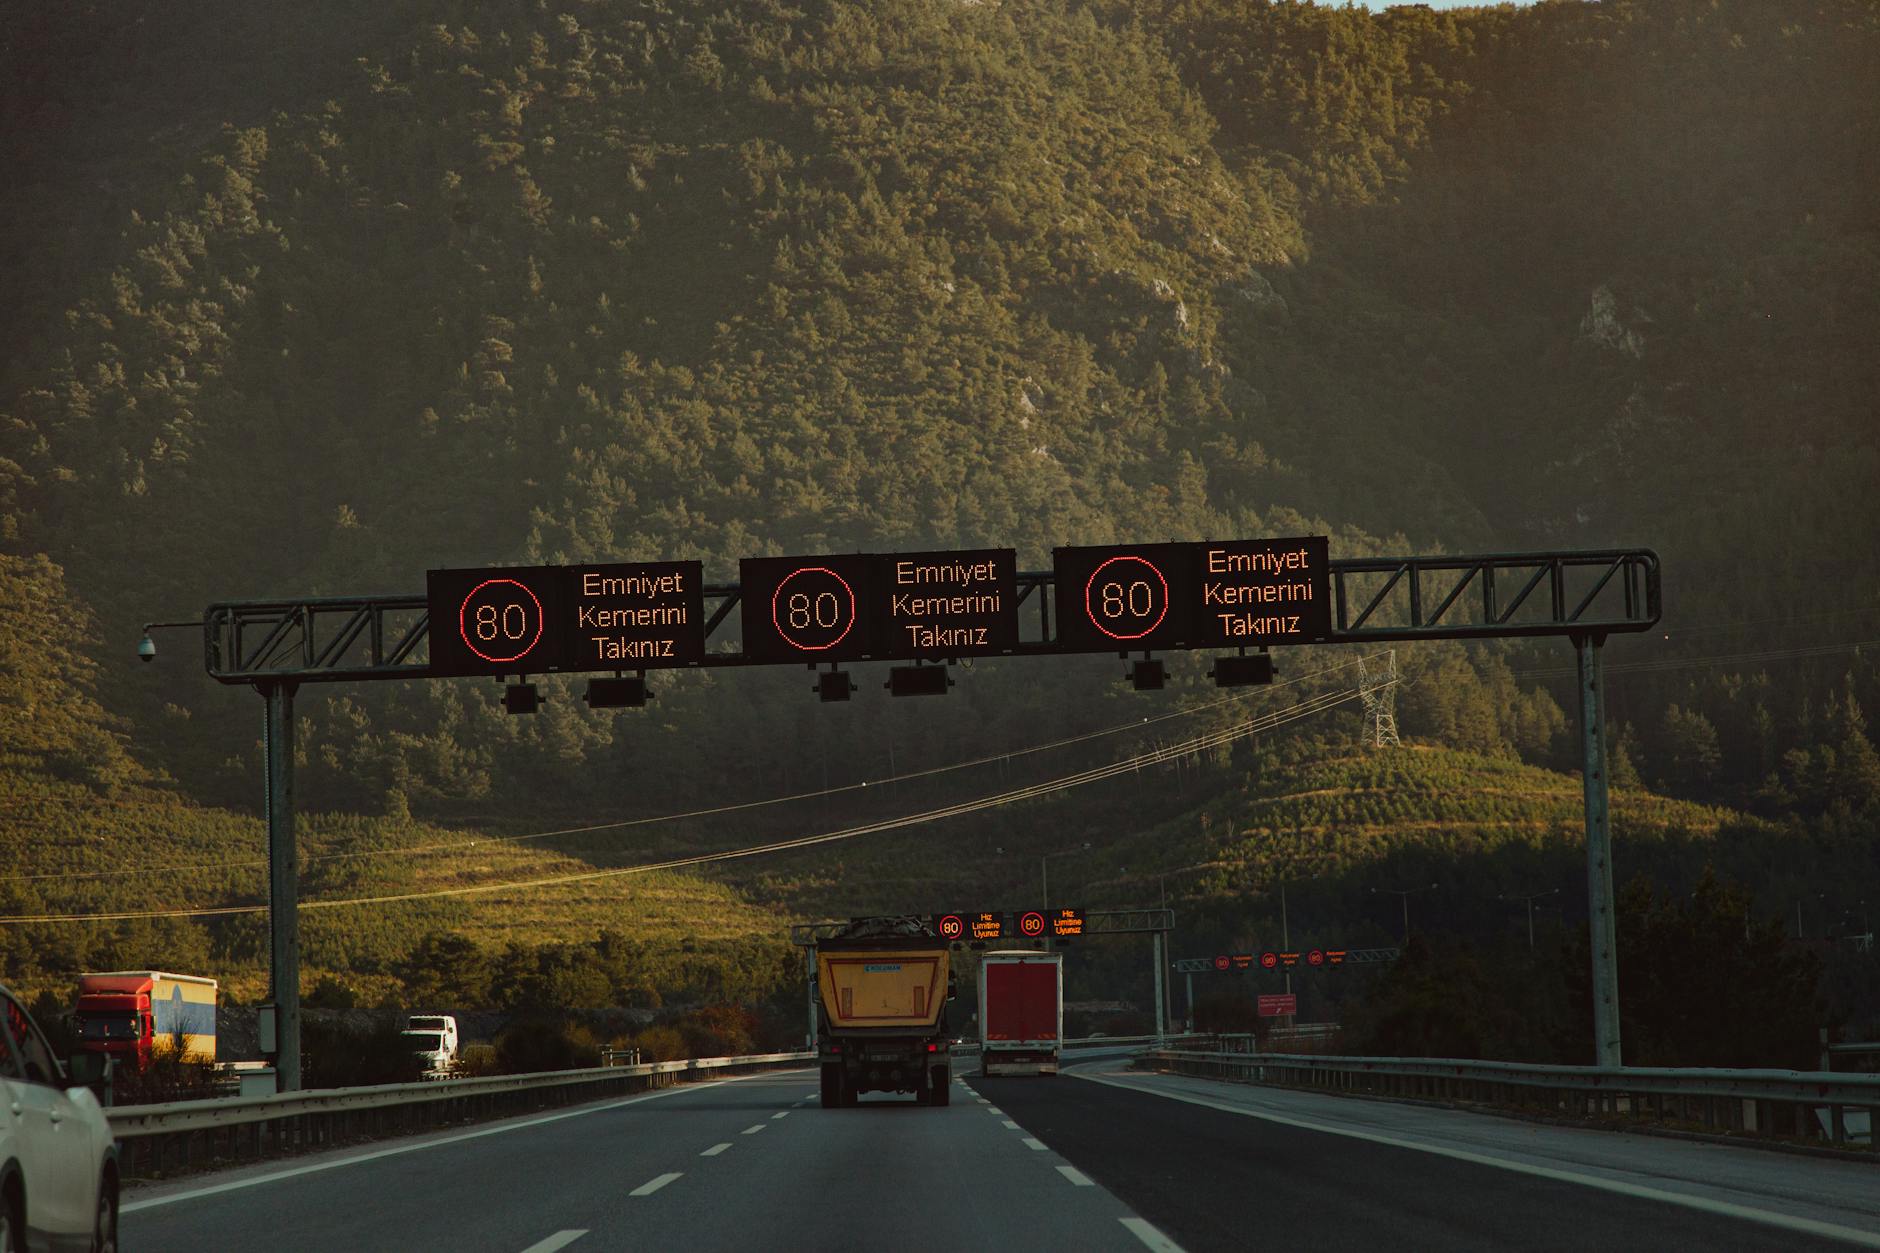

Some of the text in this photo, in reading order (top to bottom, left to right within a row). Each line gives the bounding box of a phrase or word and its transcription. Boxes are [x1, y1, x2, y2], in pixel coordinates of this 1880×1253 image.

[898, 560, 996, 587] Emniyet
[1209, 548, 1308, 575] Emniyet
[584, 572, 683, 598] Emniyet
[1205, 578, 1312, 604] Kemerini
[790, 593, 838, 628] 80
[893, 590, 999, 616] Kemerini
[1103, 582, 1151, 617] 80
[477, 605, 525, 640] 80
[579, 602, 686, 627] Kemerini
[1218, 613, 1300, 635] Takınız
[592, 637, 674, 659] Takınız
[906, 625, 987, 647] Takınız
[944, 923, 958, 933] 80
[1026, 919, 1039, 929] 80
